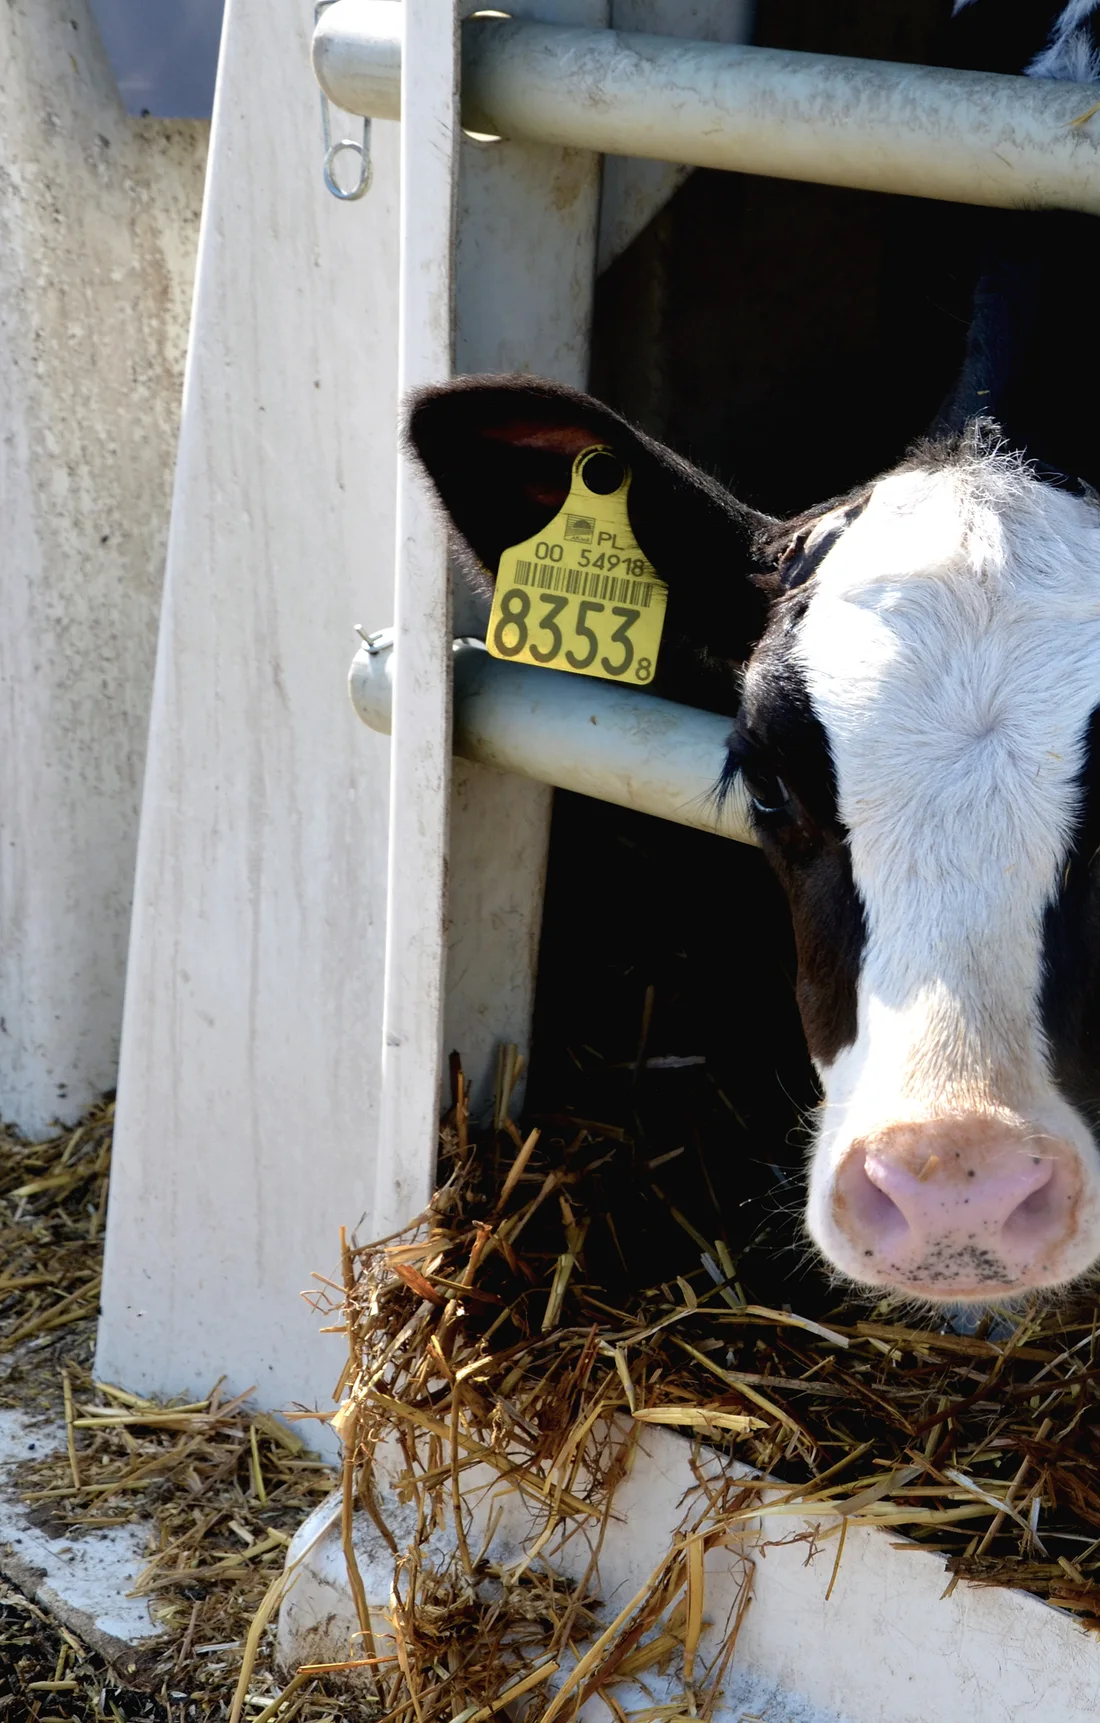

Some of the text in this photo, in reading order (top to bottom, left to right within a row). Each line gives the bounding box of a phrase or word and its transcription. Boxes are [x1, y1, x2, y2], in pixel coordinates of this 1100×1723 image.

[597, 531, 625, 551] PL
[577, 548, 646, 578] 54918
[494, 588, 652, 681] 8353 8
